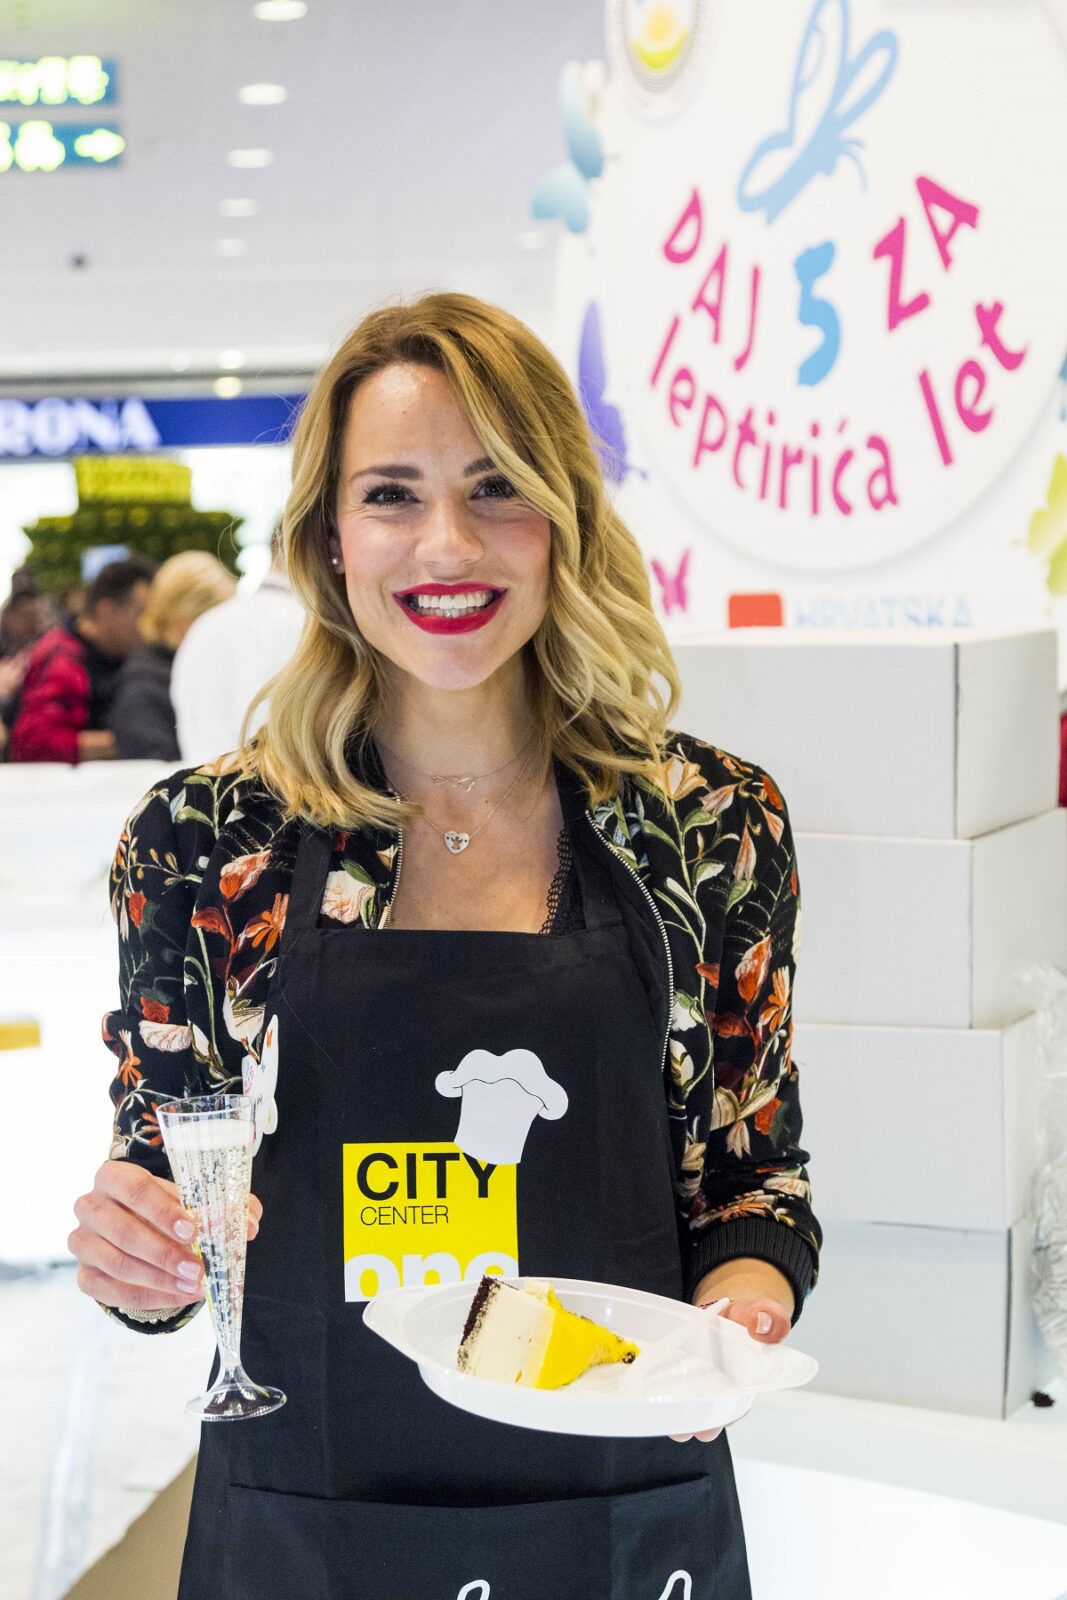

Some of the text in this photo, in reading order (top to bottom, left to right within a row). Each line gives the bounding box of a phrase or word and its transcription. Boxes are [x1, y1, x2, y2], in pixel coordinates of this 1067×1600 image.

[661, 174, 981, 386] DAJ 5 ZA
[650, 300, 1028, 517] leptirića let
[357, 1152, 498, 1201] CITY
[360, 1205, 449, 1226] CENTER
